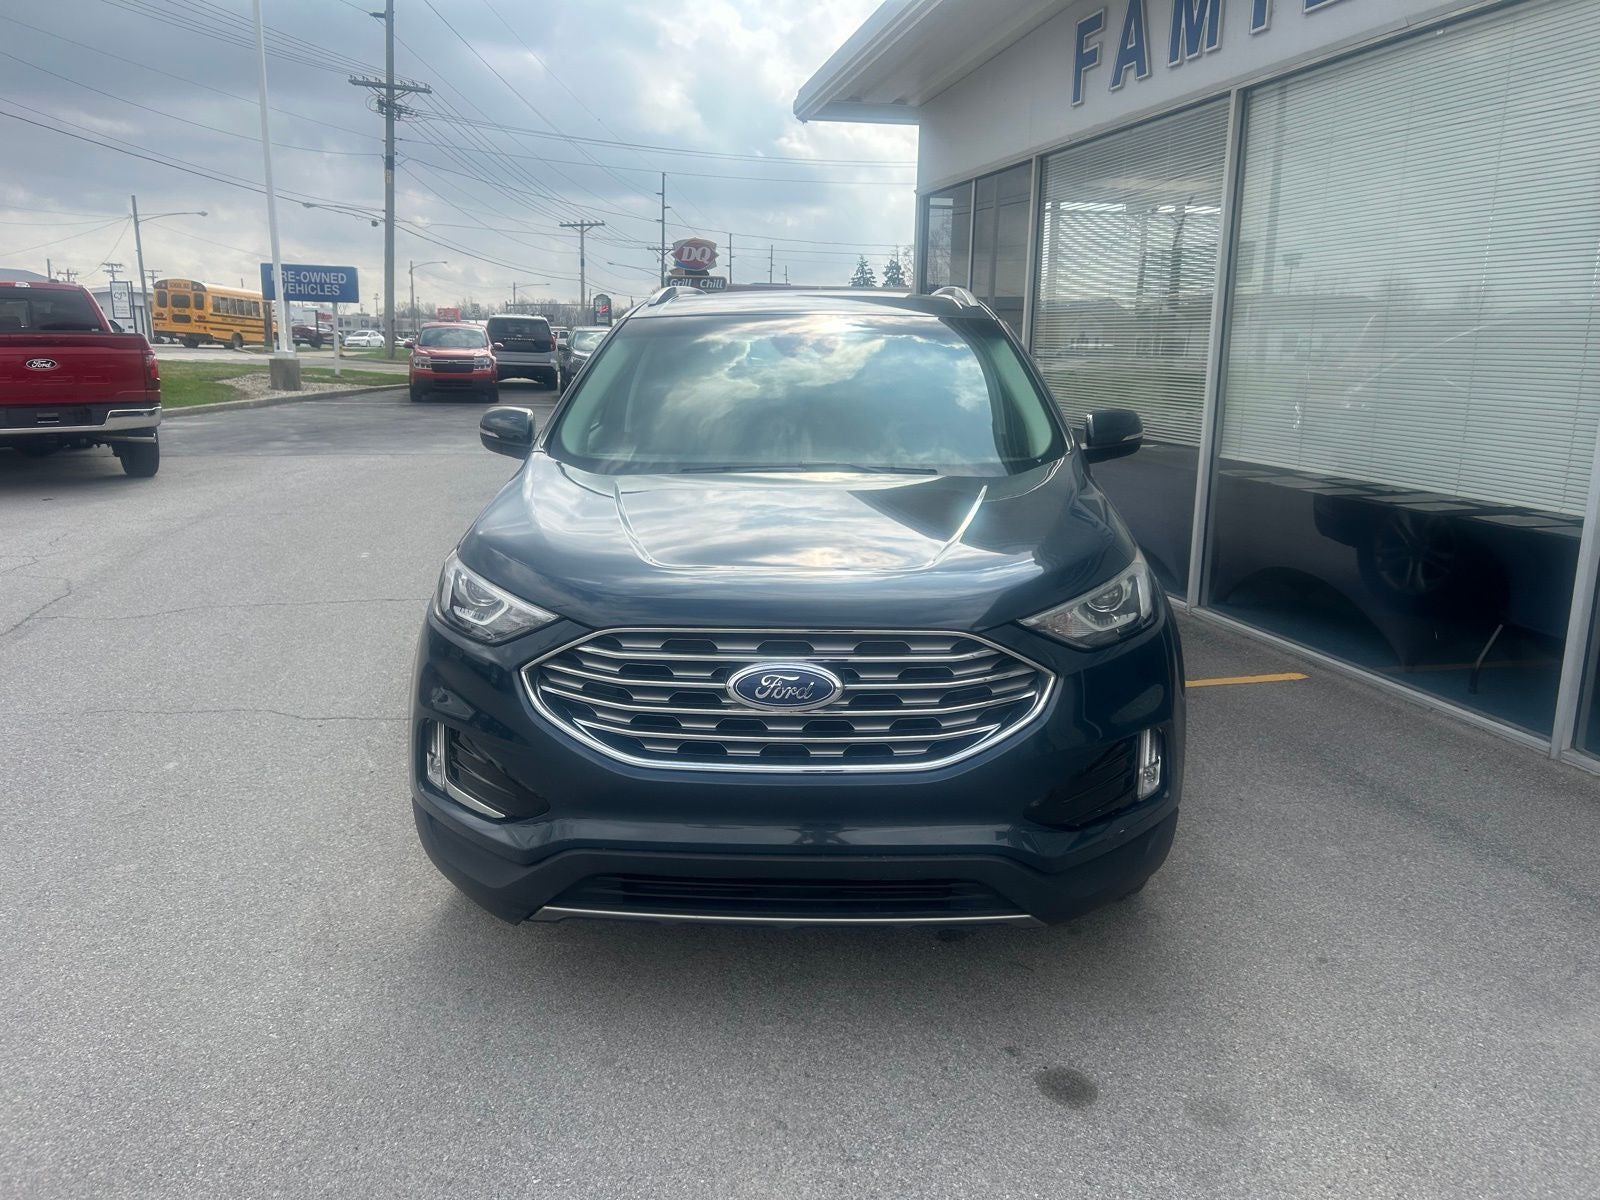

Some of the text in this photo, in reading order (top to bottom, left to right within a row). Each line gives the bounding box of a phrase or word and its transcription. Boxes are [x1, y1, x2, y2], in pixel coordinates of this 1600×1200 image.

[681, 246, 711, 264] DQ
[669, 278, 723, 289] Grill Chill
[31, 360, 52, 368] Ford
[755, 674, 815, 700] Ford
